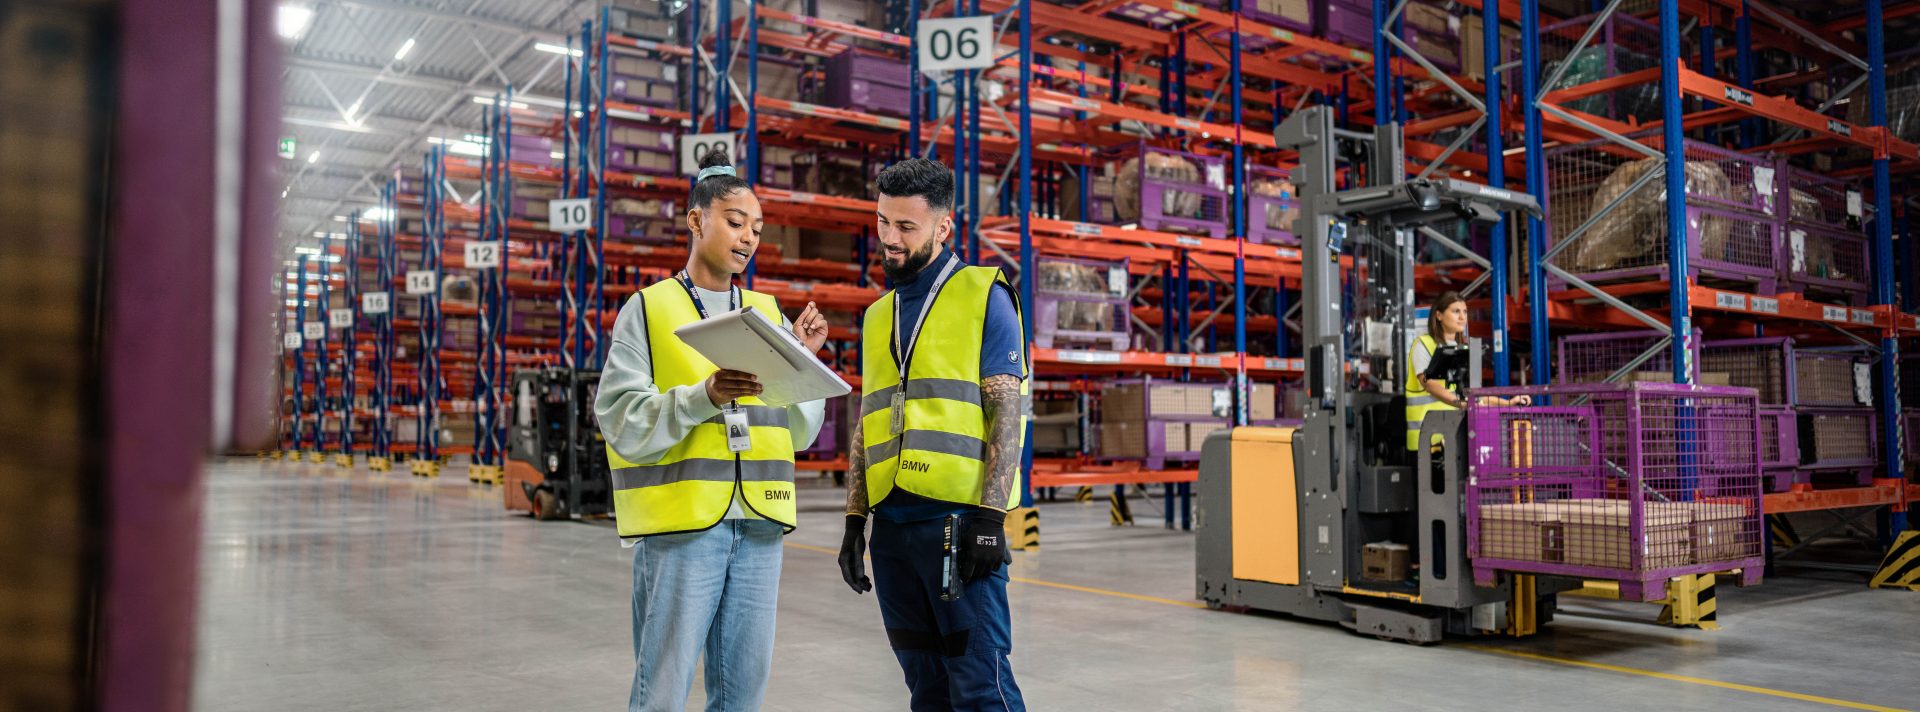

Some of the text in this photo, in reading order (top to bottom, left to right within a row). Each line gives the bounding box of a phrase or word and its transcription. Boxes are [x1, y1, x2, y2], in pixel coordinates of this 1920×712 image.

[930, 27, 979, 61] 06
[560, 205, 586, 224] 10
[471, 247, 493, 263] 12
[411, 275, 430, 288] 14
[369, 297, 384, 308] 16
[901, 460, 930, 473] BMW
[765, 490, 790, 500] BMW
